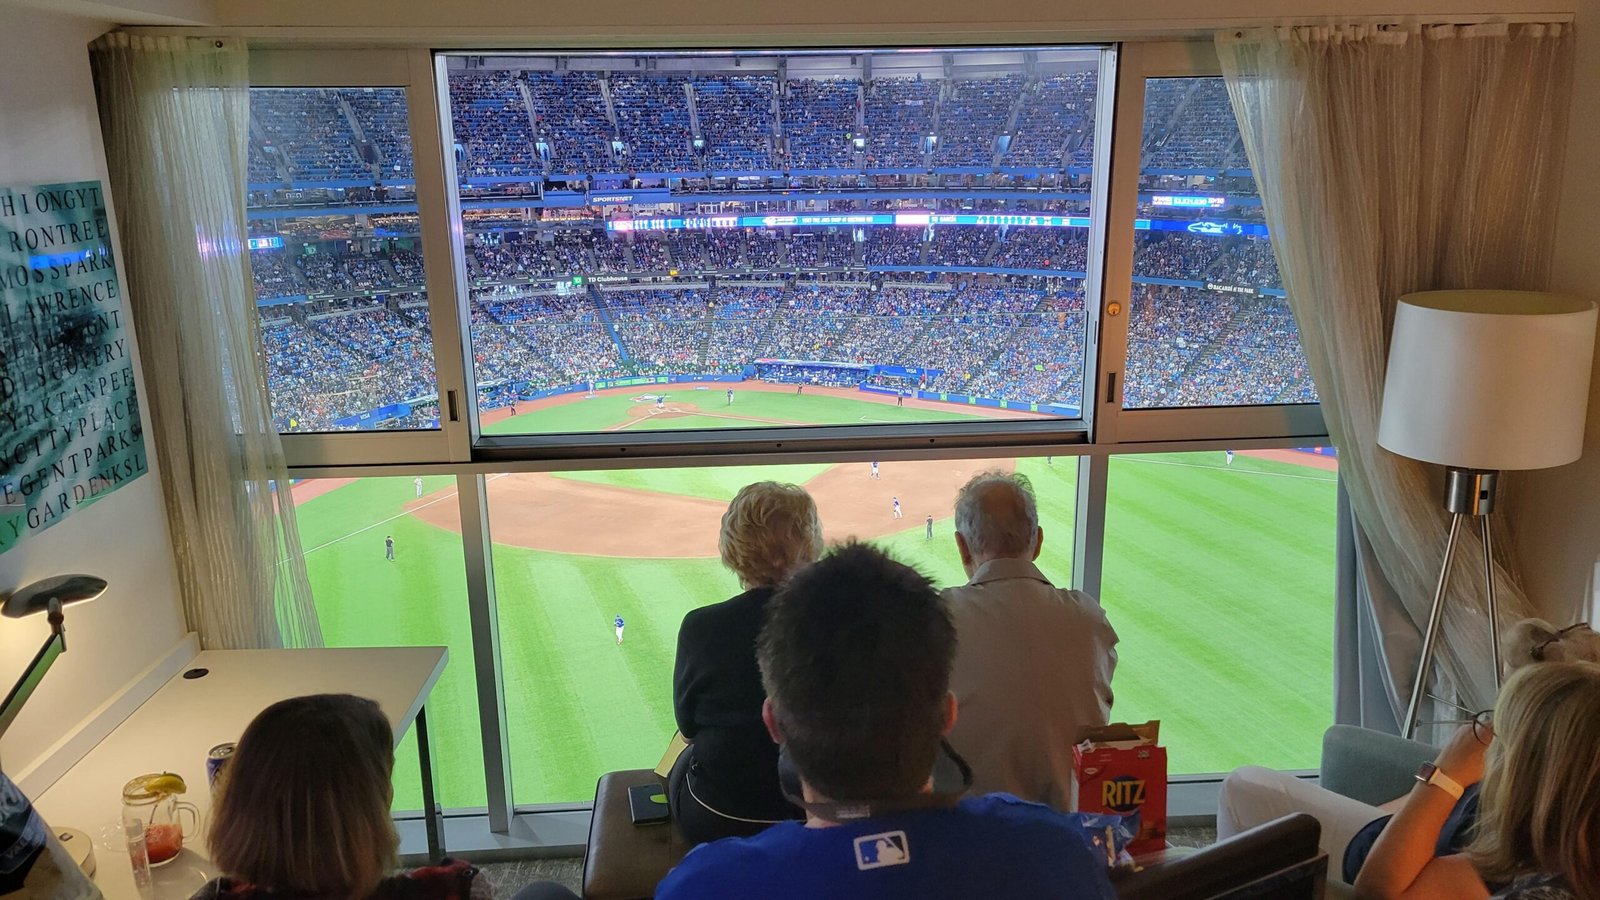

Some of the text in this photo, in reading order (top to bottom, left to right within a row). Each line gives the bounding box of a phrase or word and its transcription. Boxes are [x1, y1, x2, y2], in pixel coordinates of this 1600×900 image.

[592, 195, 633, 203] SPORTSNET
[597, 275, 628, 283] Clubhouse
[1102, 780, 1146, 807] RITZ
